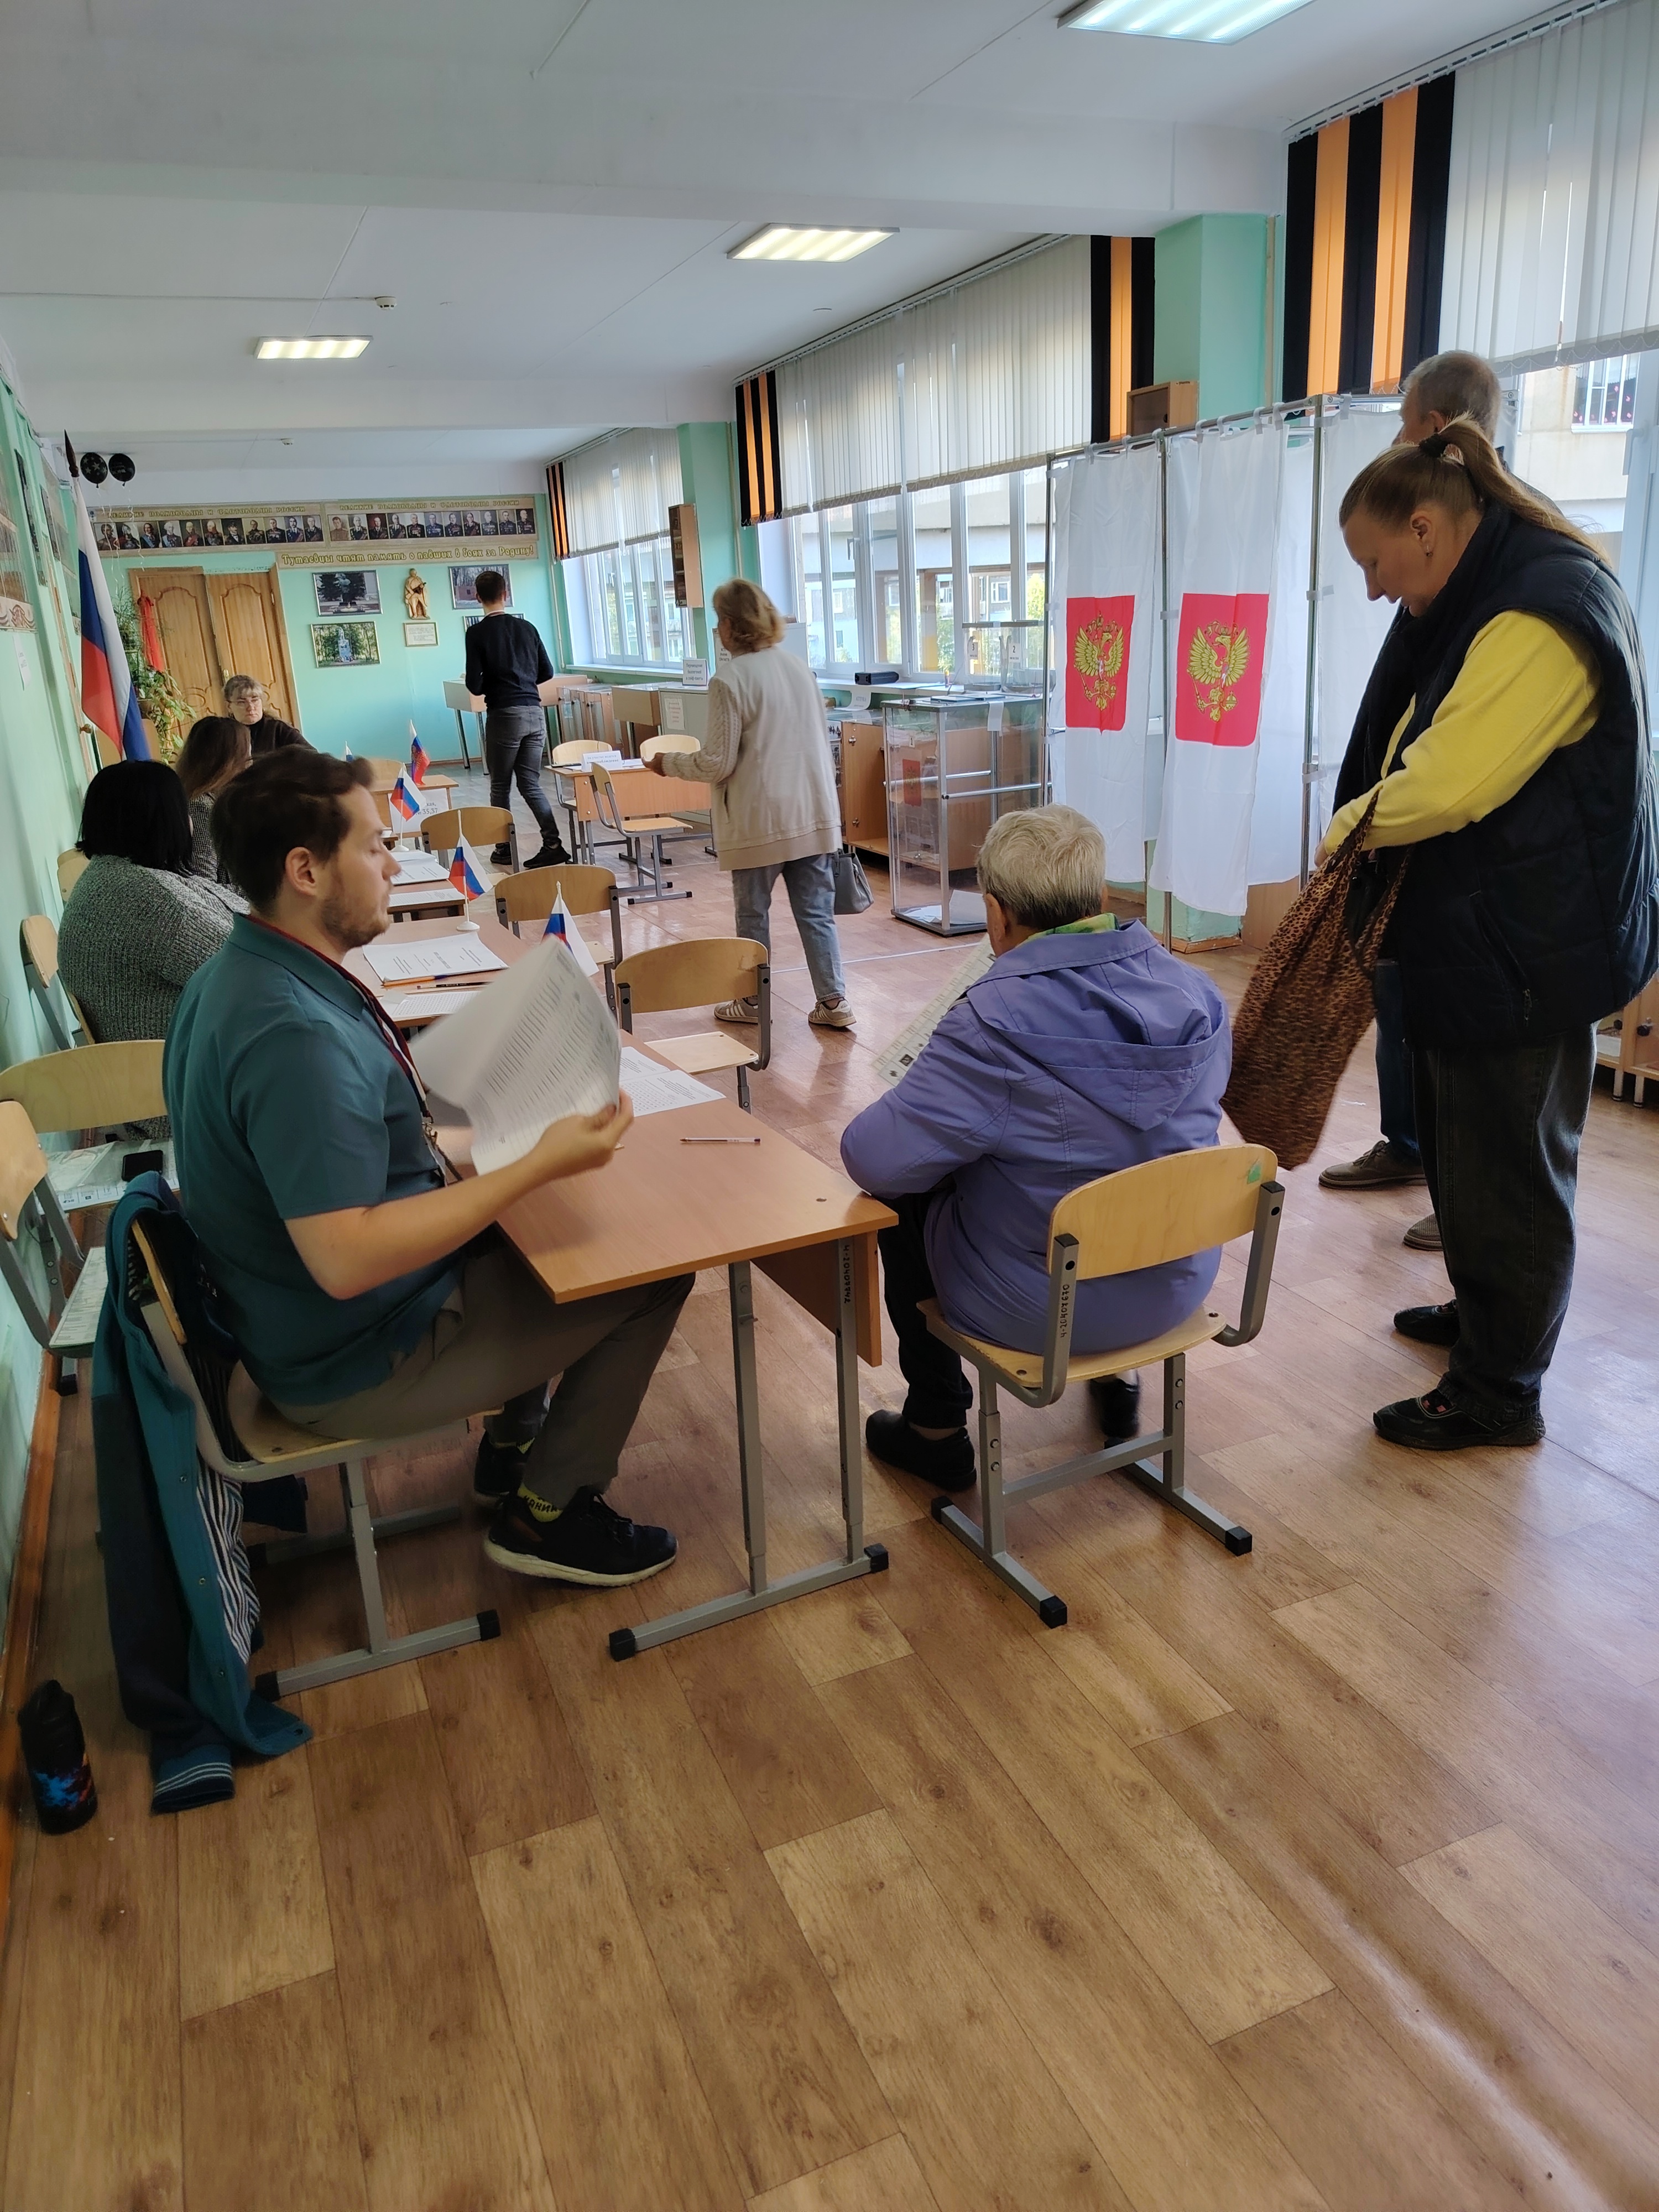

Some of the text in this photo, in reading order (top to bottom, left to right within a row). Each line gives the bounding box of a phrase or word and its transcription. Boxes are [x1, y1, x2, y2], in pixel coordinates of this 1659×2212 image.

[281, 553, 333, 566] Тутаевцы
[336, 553, 365, 562] чтят
[367, 552, 406, 561] память
[417, 549, 452, 560] павших
[455, 548, 461, 558] в
[462, 547, 483, 558] боях
[498, 545, 534, 557] Родину!
[1013, 645, 1016, 653] 2
